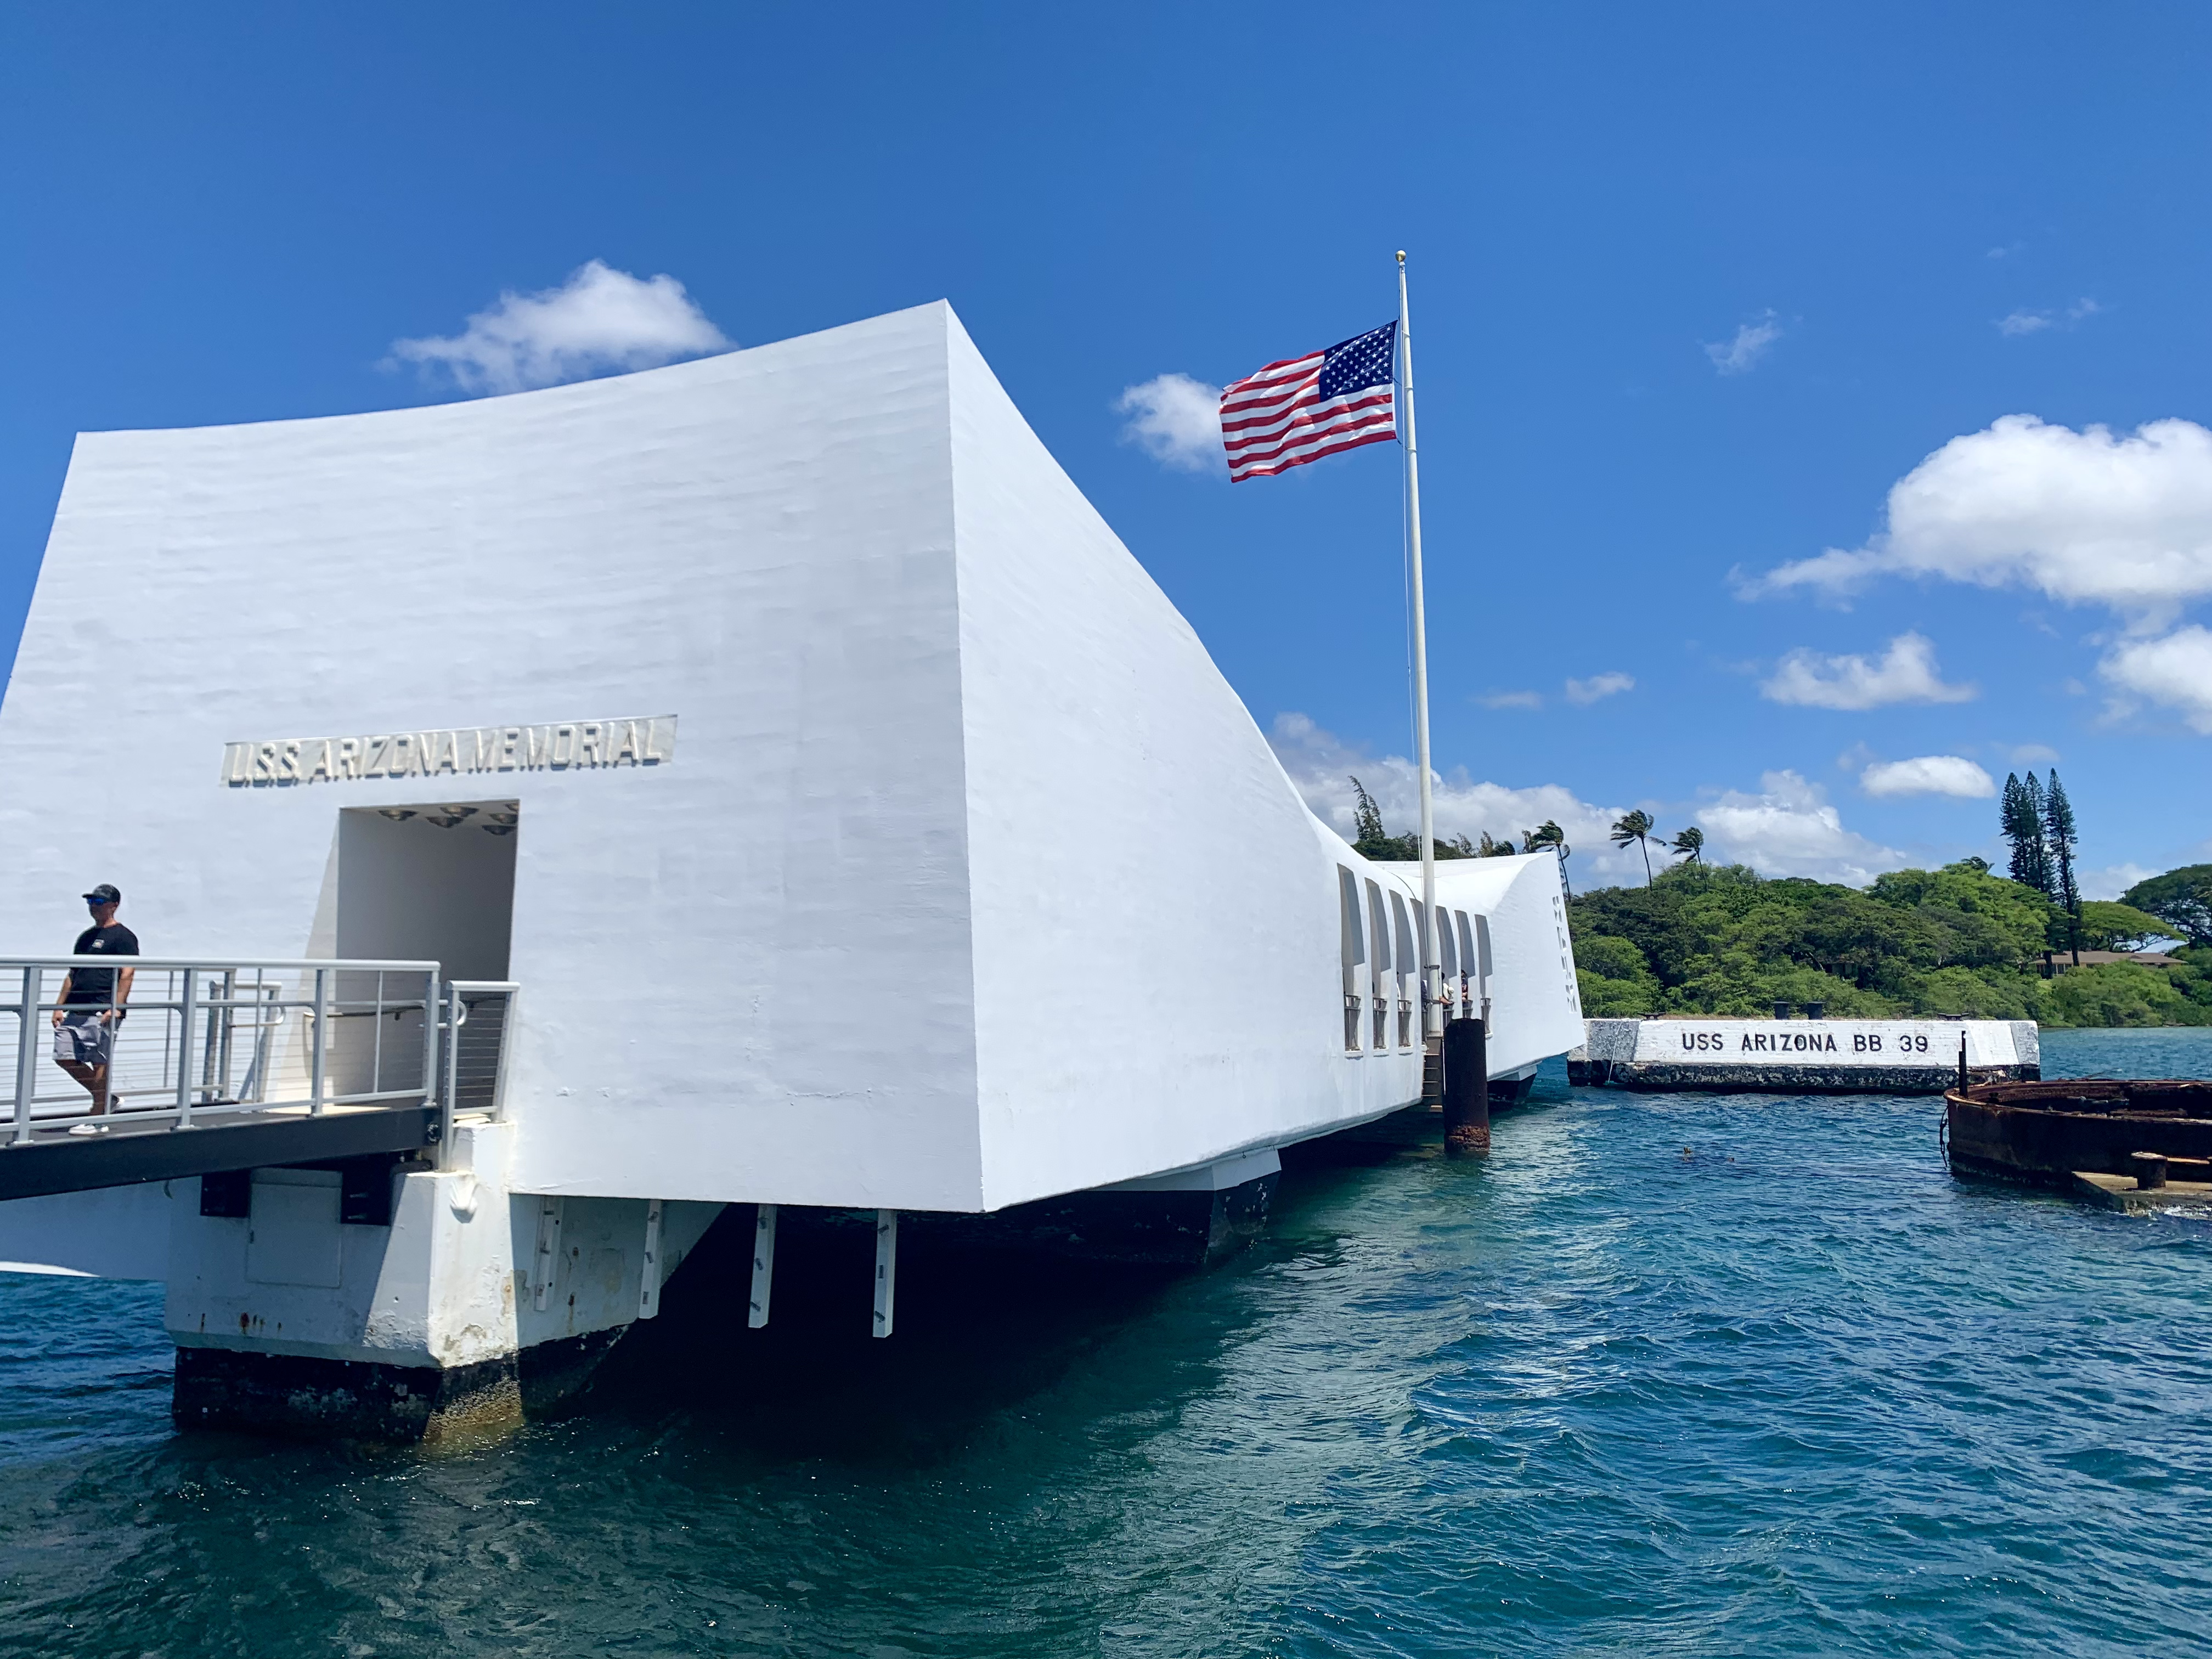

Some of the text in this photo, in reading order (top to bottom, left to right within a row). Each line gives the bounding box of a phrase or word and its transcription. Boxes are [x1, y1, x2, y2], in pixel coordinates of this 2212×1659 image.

[309, 732, 459, 781] ARIZONA
[468, 720, 662, 772] MEMORIAL
[1681, 1033, 1929, 1053] USS ARIZONA BB 39
